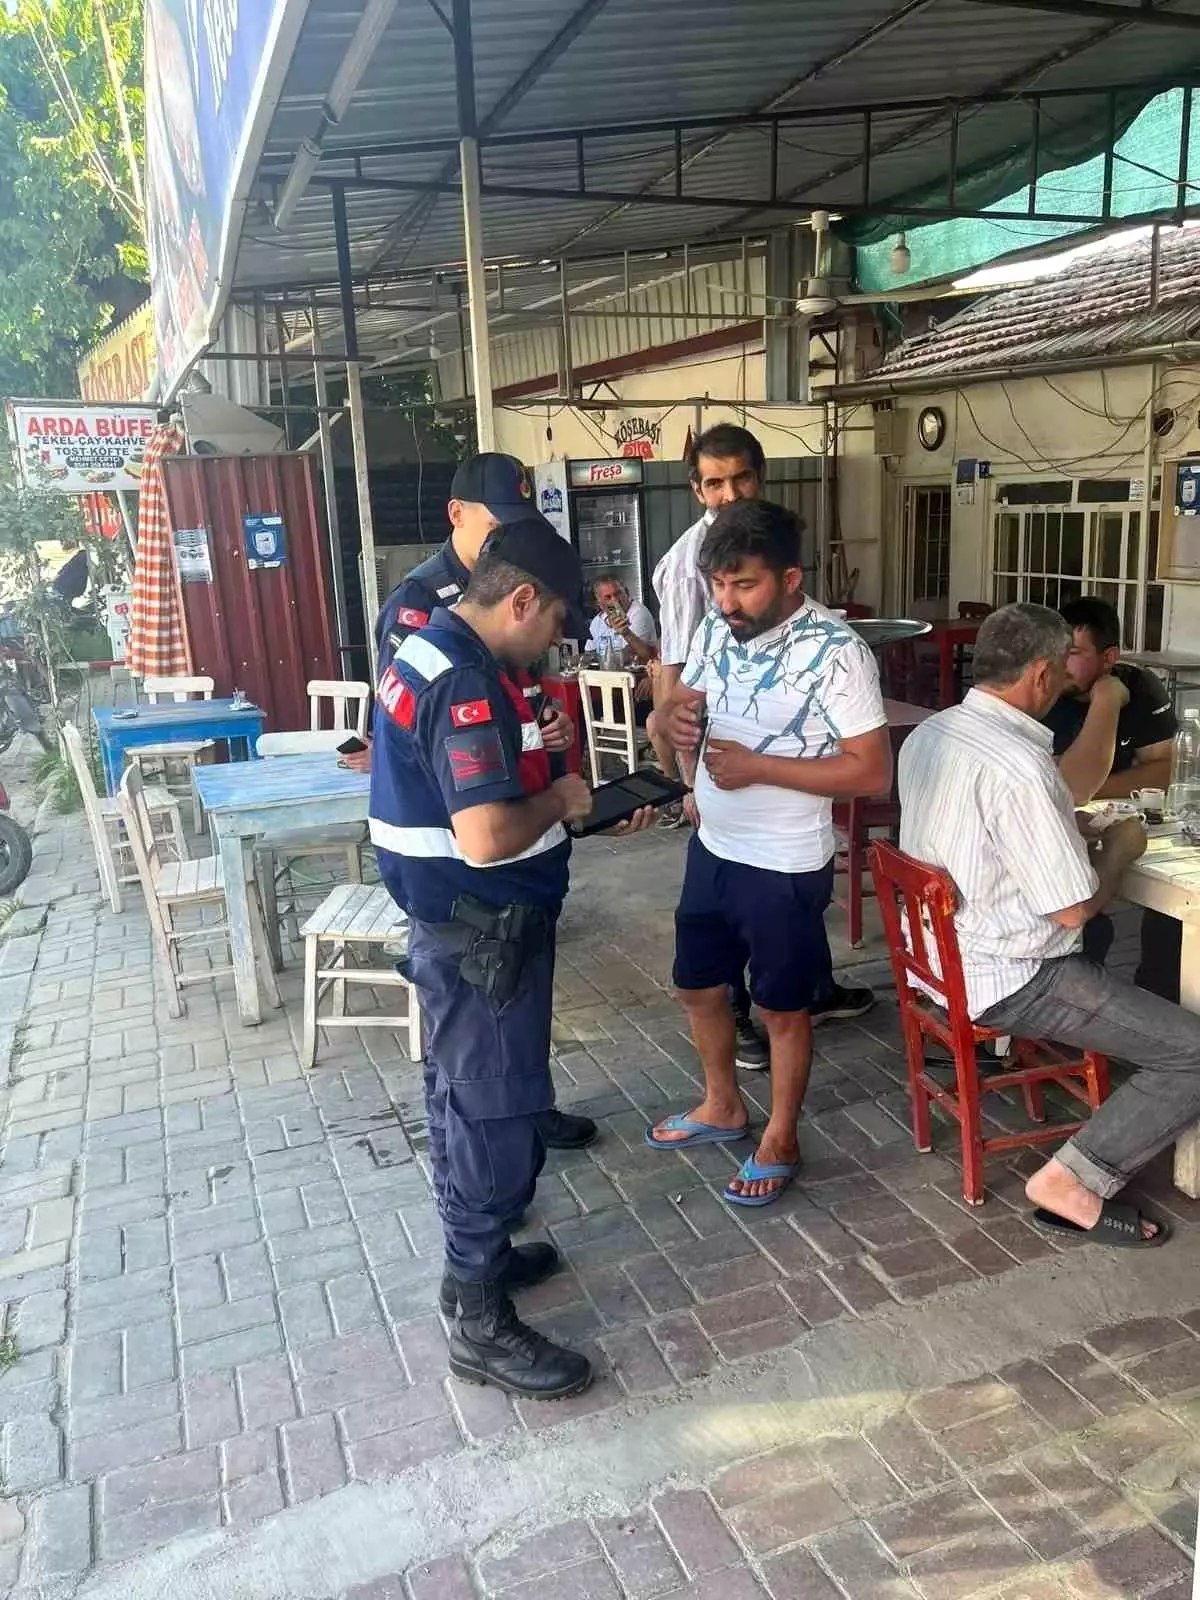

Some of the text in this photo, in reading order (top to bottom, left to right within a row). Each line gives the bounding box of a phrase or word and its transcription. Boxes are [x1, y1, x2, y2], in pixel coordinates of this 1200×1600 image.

[28, 415, 153, 437] ARDA BÜFE
[589, 463, 623, 481] Freşa
